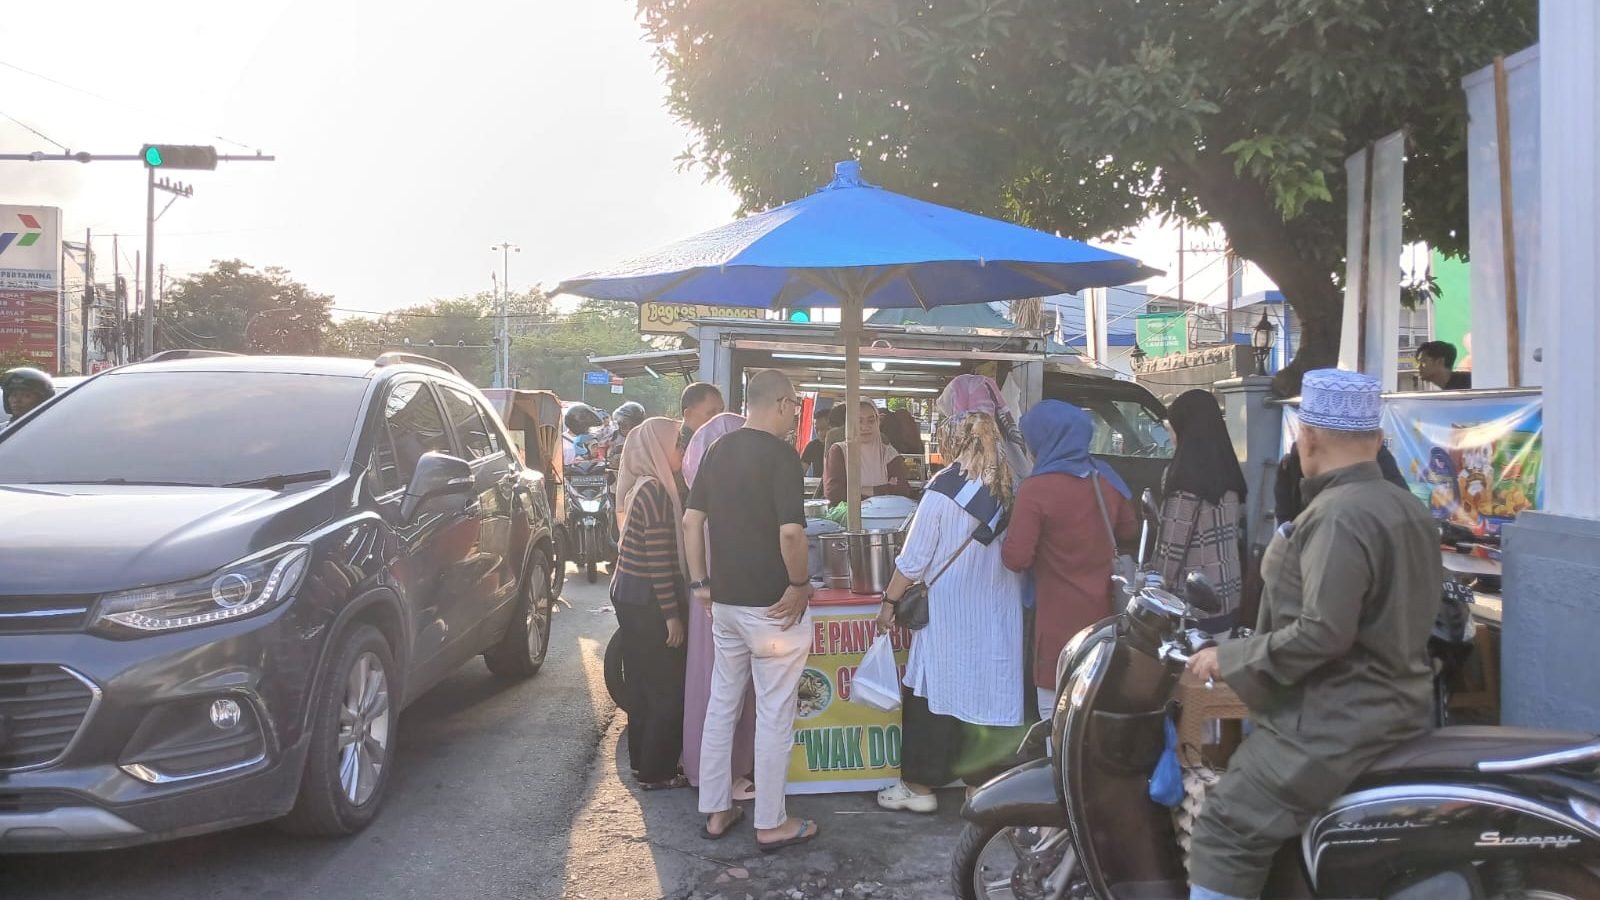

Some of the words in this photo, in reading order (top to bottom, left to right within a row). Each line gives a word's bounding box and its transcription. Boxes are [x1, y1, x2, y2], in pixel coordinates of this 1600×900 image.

[0, 271, 52, 280] PERTAMINA
[1338, 821, 1424, 832] Stylish
[1474, 831, 1581, 849] Scoopy
